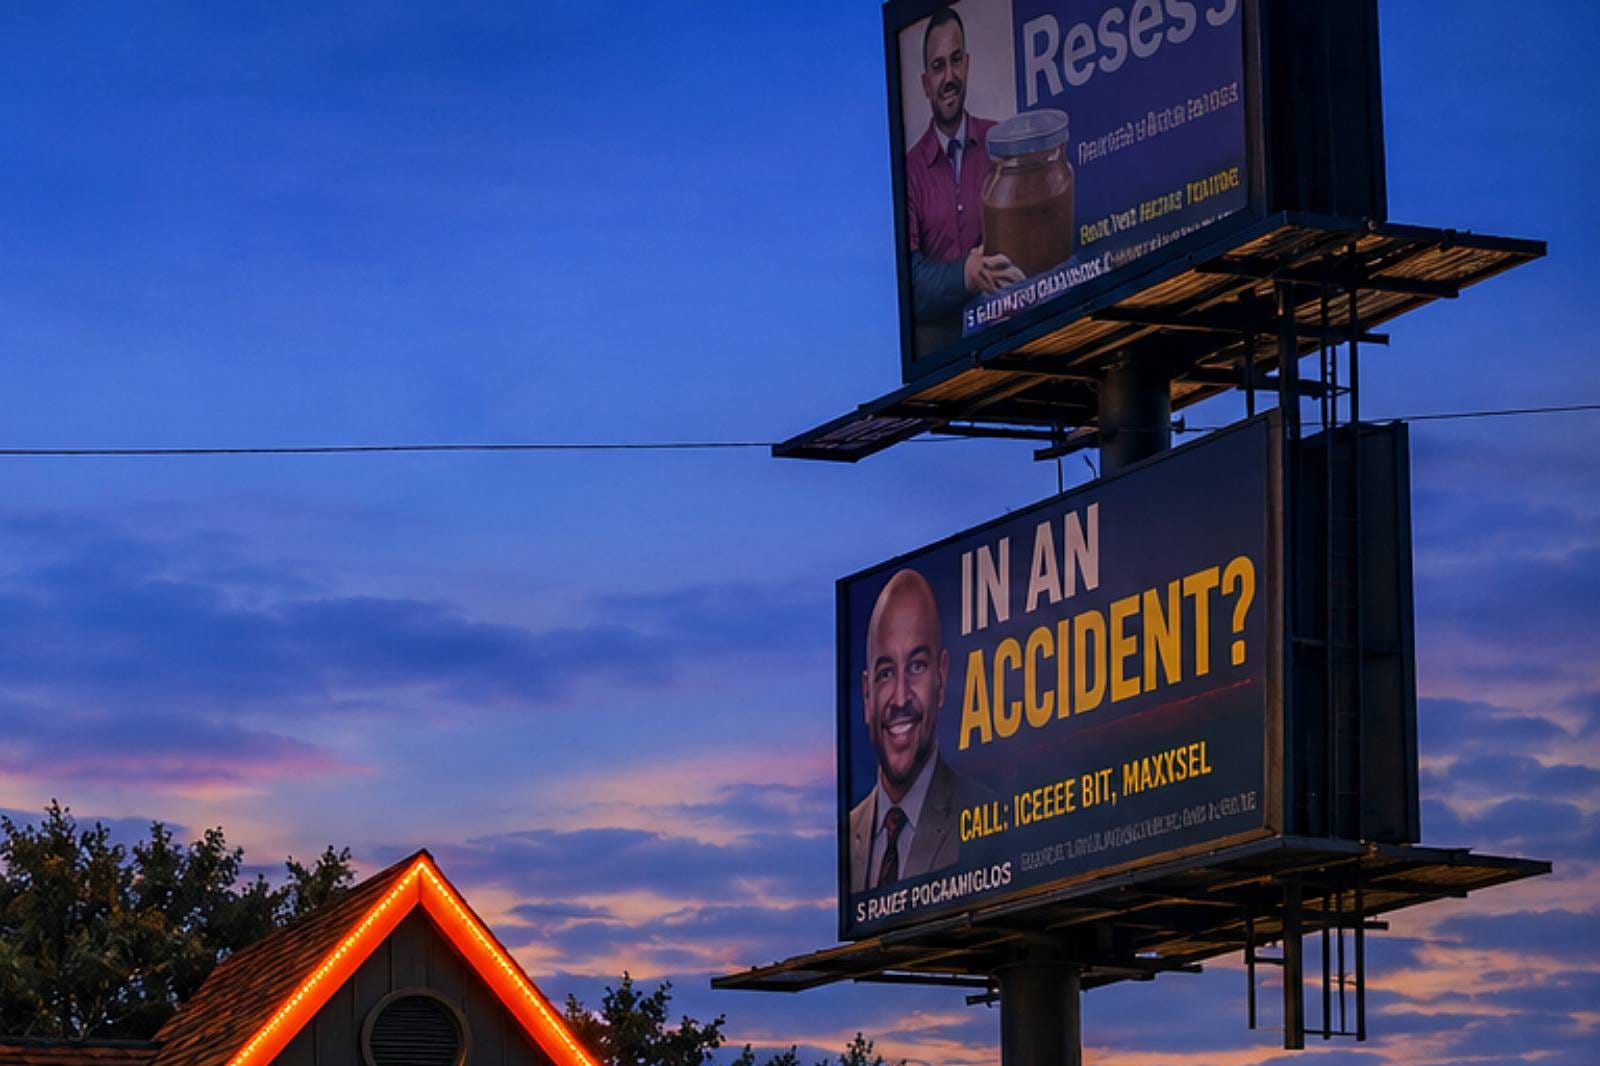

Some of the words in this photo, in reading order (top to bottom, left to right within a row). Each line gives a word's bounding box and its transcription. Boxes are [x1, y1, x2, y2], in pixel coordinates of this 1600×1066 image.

[961, 537, 1009, 636] IN
[1025, 502, 1099, 613] AN
[959, 556, 1256, 751] ACCIDENT?
[960, 800, 1009, 842] CALL:
[1082, 768, 1117, 807] BIT,
